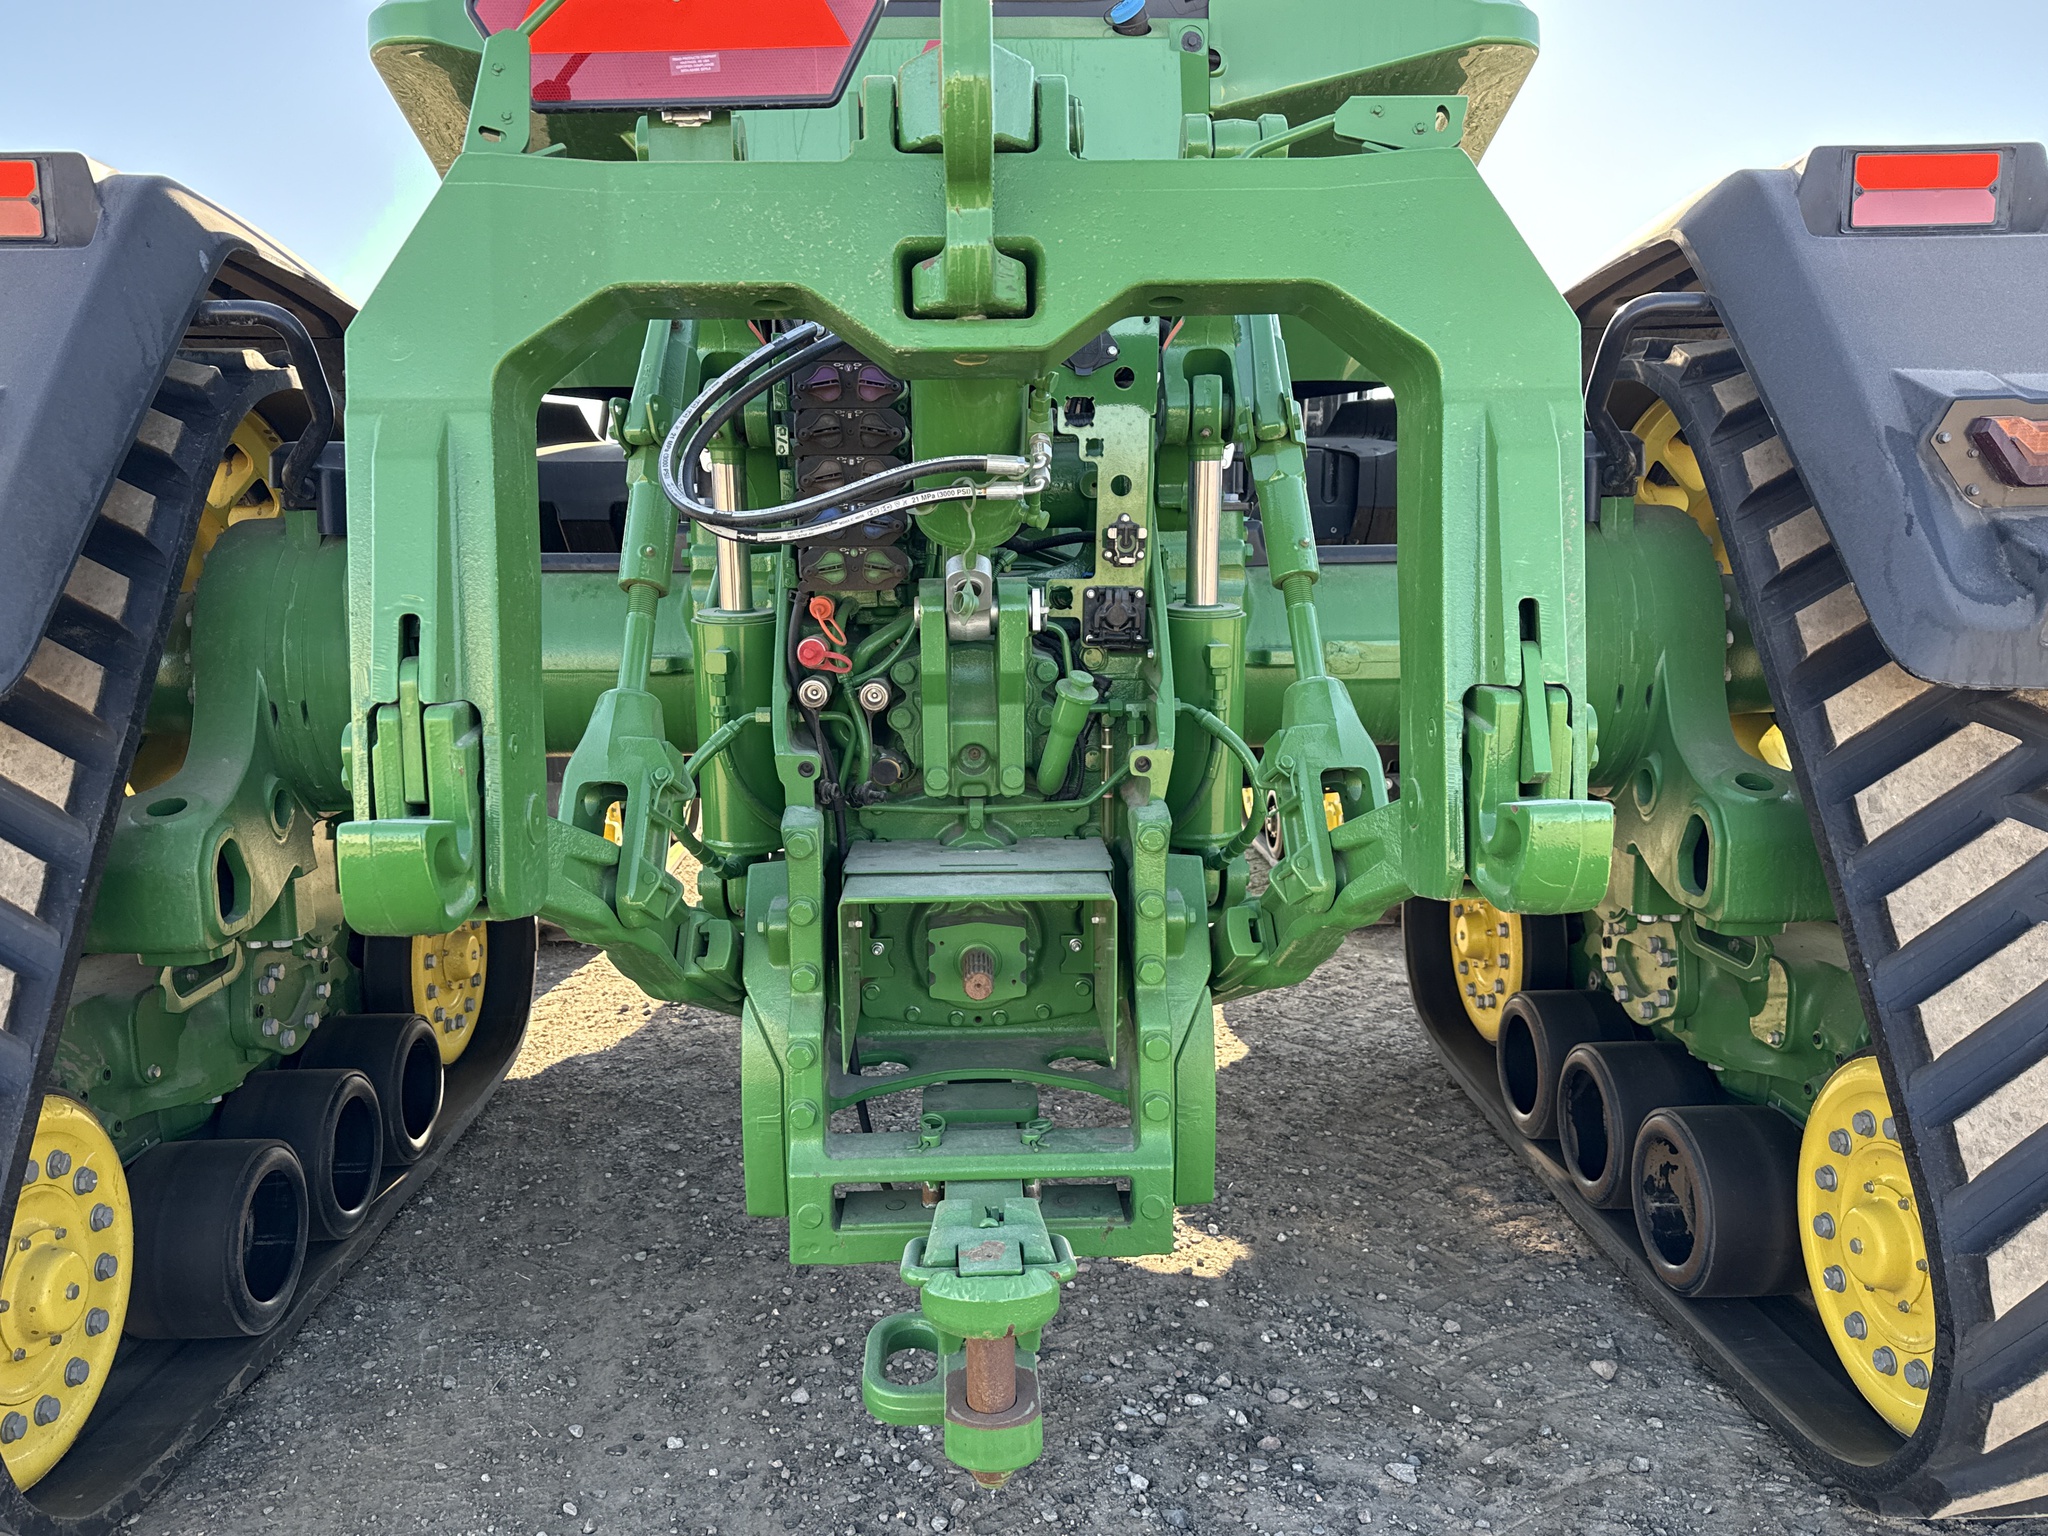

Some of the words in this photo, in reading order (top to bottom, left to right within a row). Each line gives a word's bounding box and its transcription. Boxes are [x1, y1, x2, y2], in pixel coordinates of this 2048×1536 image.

[921, 493, 936, 502] MPa
[936, 489, 956, 499] (3000
[956, 487, 971, 497] PSI)
